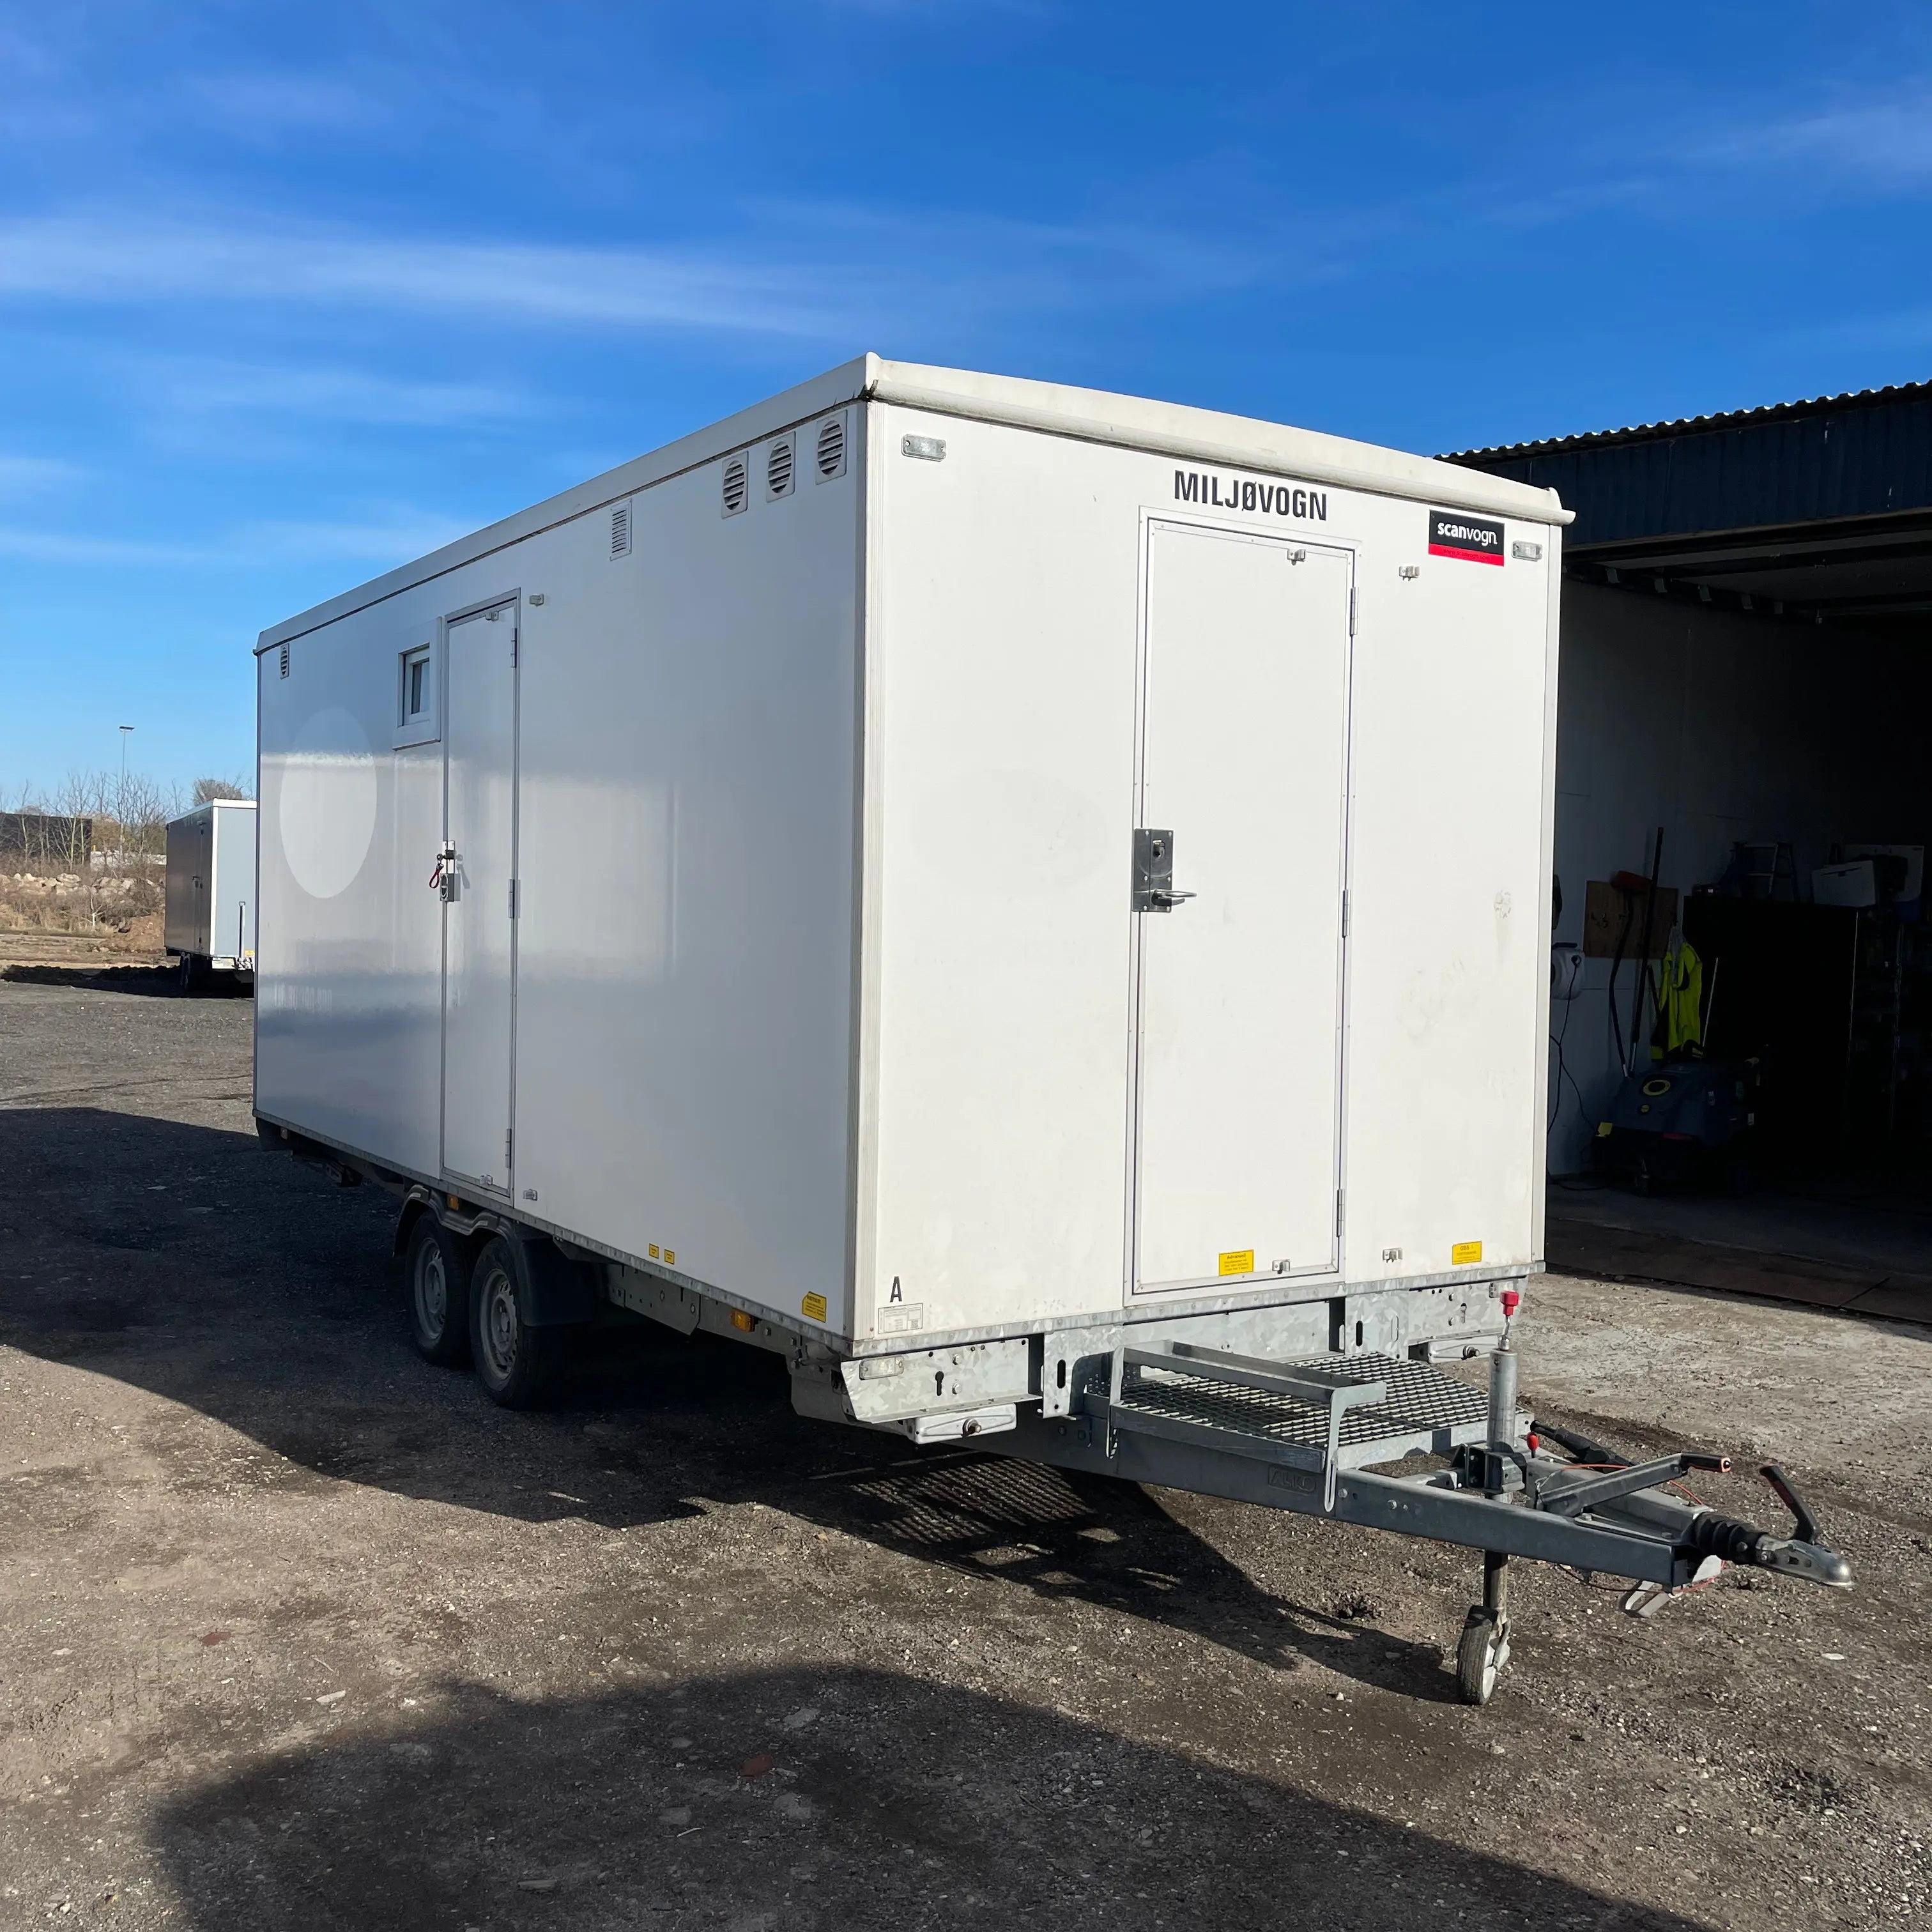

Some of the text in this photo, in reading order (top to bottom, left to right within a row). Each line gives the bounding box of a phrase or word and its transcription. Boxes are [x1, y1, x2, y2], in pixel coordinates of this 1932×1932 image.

[1174, 470, 1326, 521] MILJØVOGN
[1438, 522, 1498, 546] scanvogn
[889, 1276, 902, 1303] A
